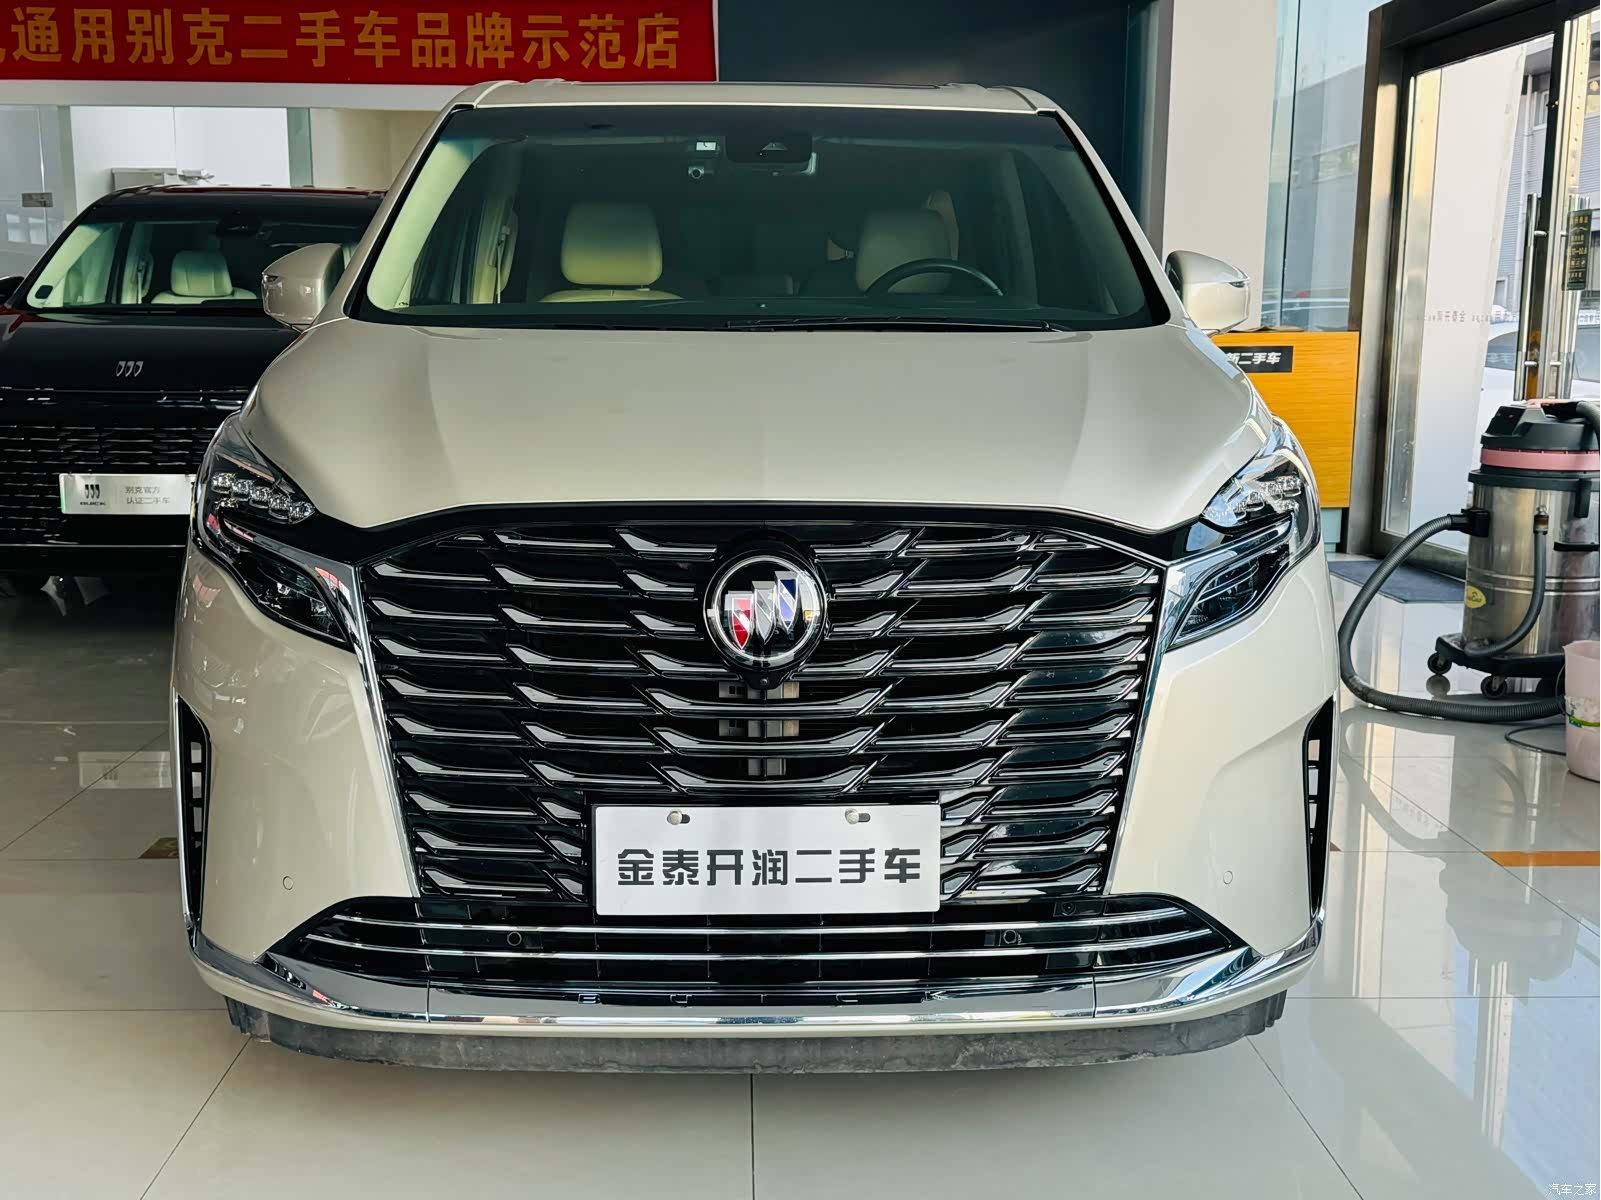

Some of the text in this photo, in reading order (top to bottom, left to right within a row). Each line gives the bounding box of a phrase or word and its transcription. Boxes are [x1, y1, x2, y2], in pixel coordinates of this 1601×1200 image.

[0, 7, 679, 69] 通用别克二手车品牌示范店
[618, 848, 921, 886] 金泰开润二手车
